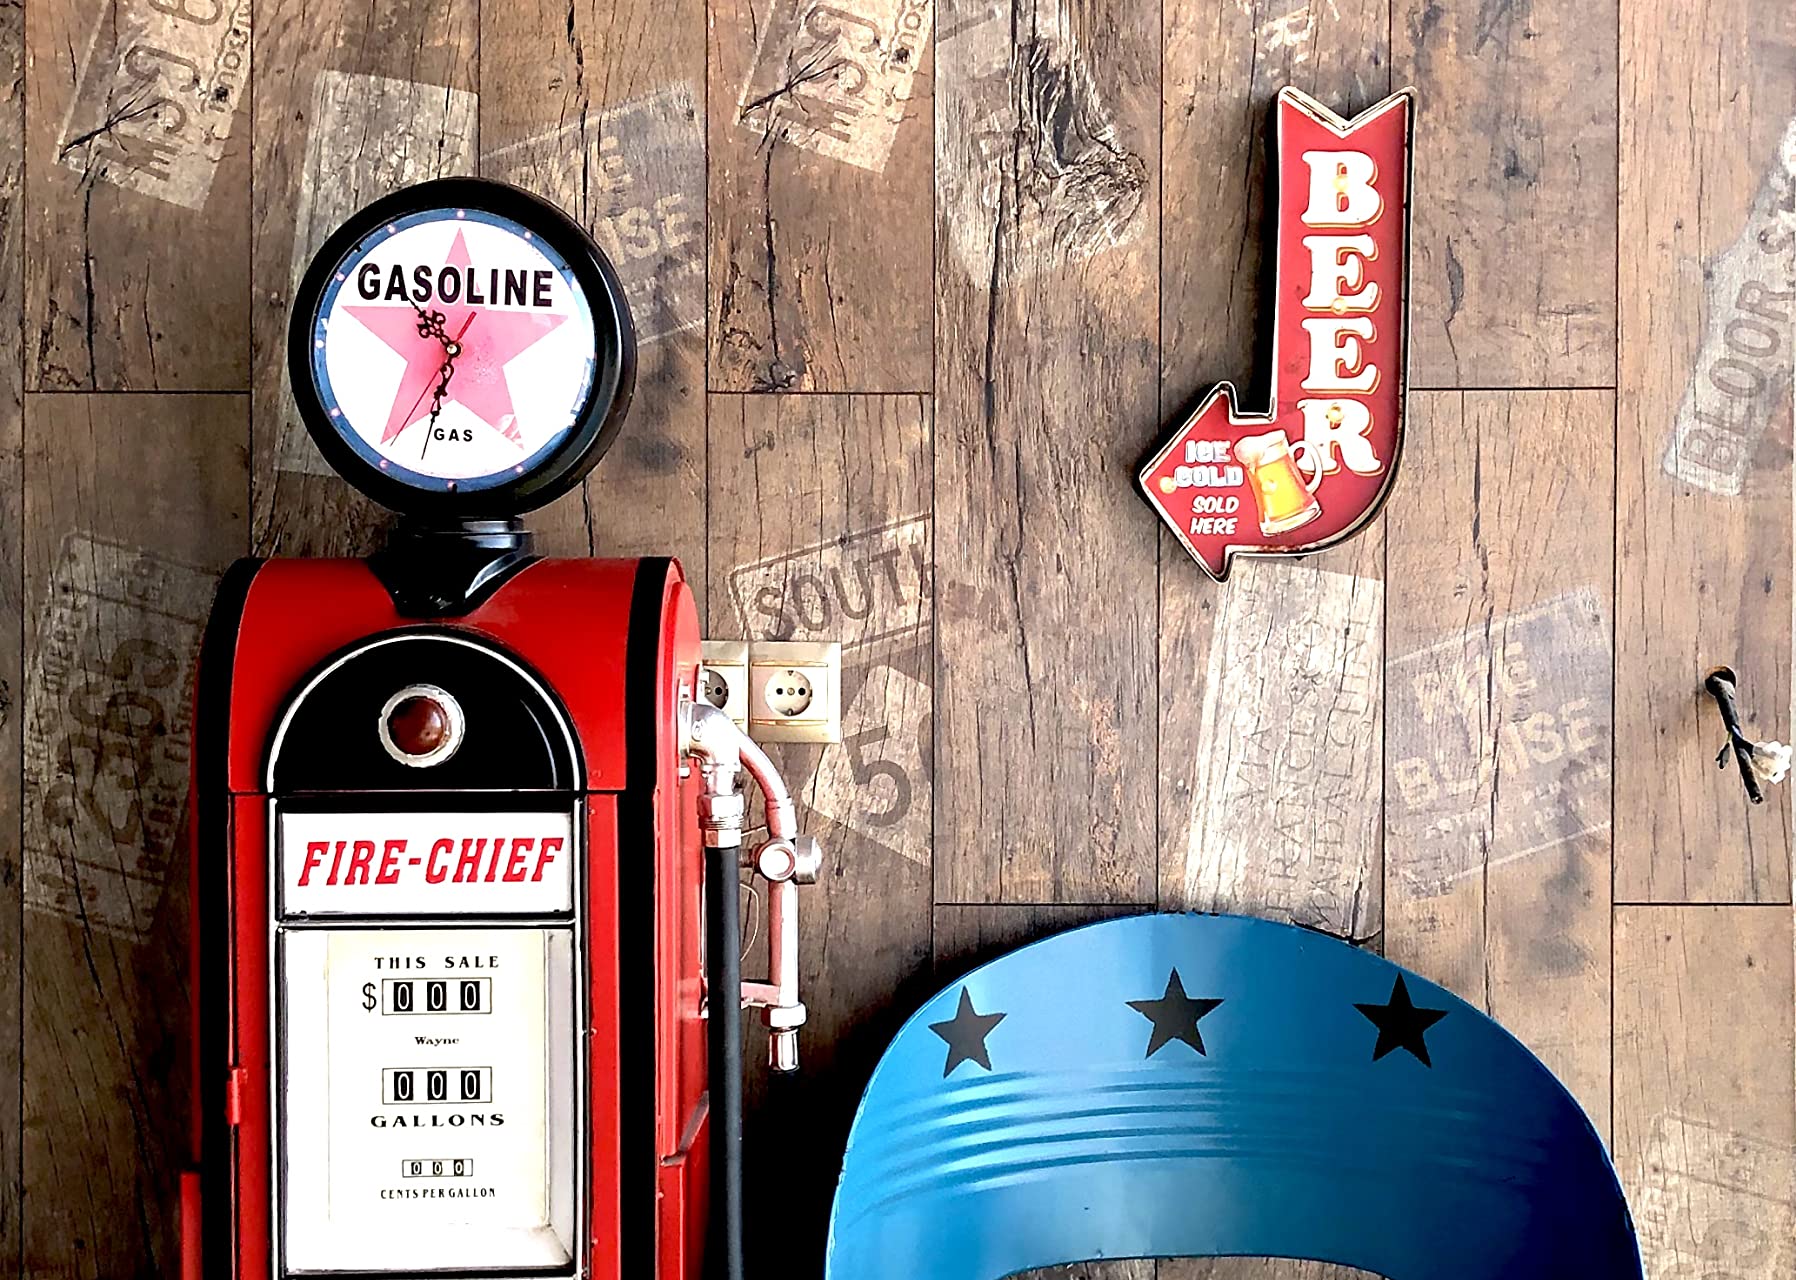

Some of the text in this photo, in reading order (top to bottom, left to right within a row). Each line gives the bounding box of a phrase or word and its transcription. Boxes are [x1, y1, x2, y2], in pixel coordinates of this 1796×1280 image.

[357, 263, 553, 308] GASOLINE
[1296, 149, 1385, 475] BEER
[1679, 279, 1794, 476] BLOOR
[433, 427, 473, 442] GAS
[1185, 440, 1231, 463] ICE
[1174, 466, 1244, 488] COLD
[1191, 496, 1239, 514] SOLD
[1190, 517, 1238, 535] HERE
[298, 837, 564, 887] FIRE-CHIEF
[374, 955, 500, 969] THIS SALE
[414, 1036, 460, 1047] Wayne
[370, 1113, 505, 1128] GALLONS
[380, 1187, 496, 1200] CENTS PER GALLON
